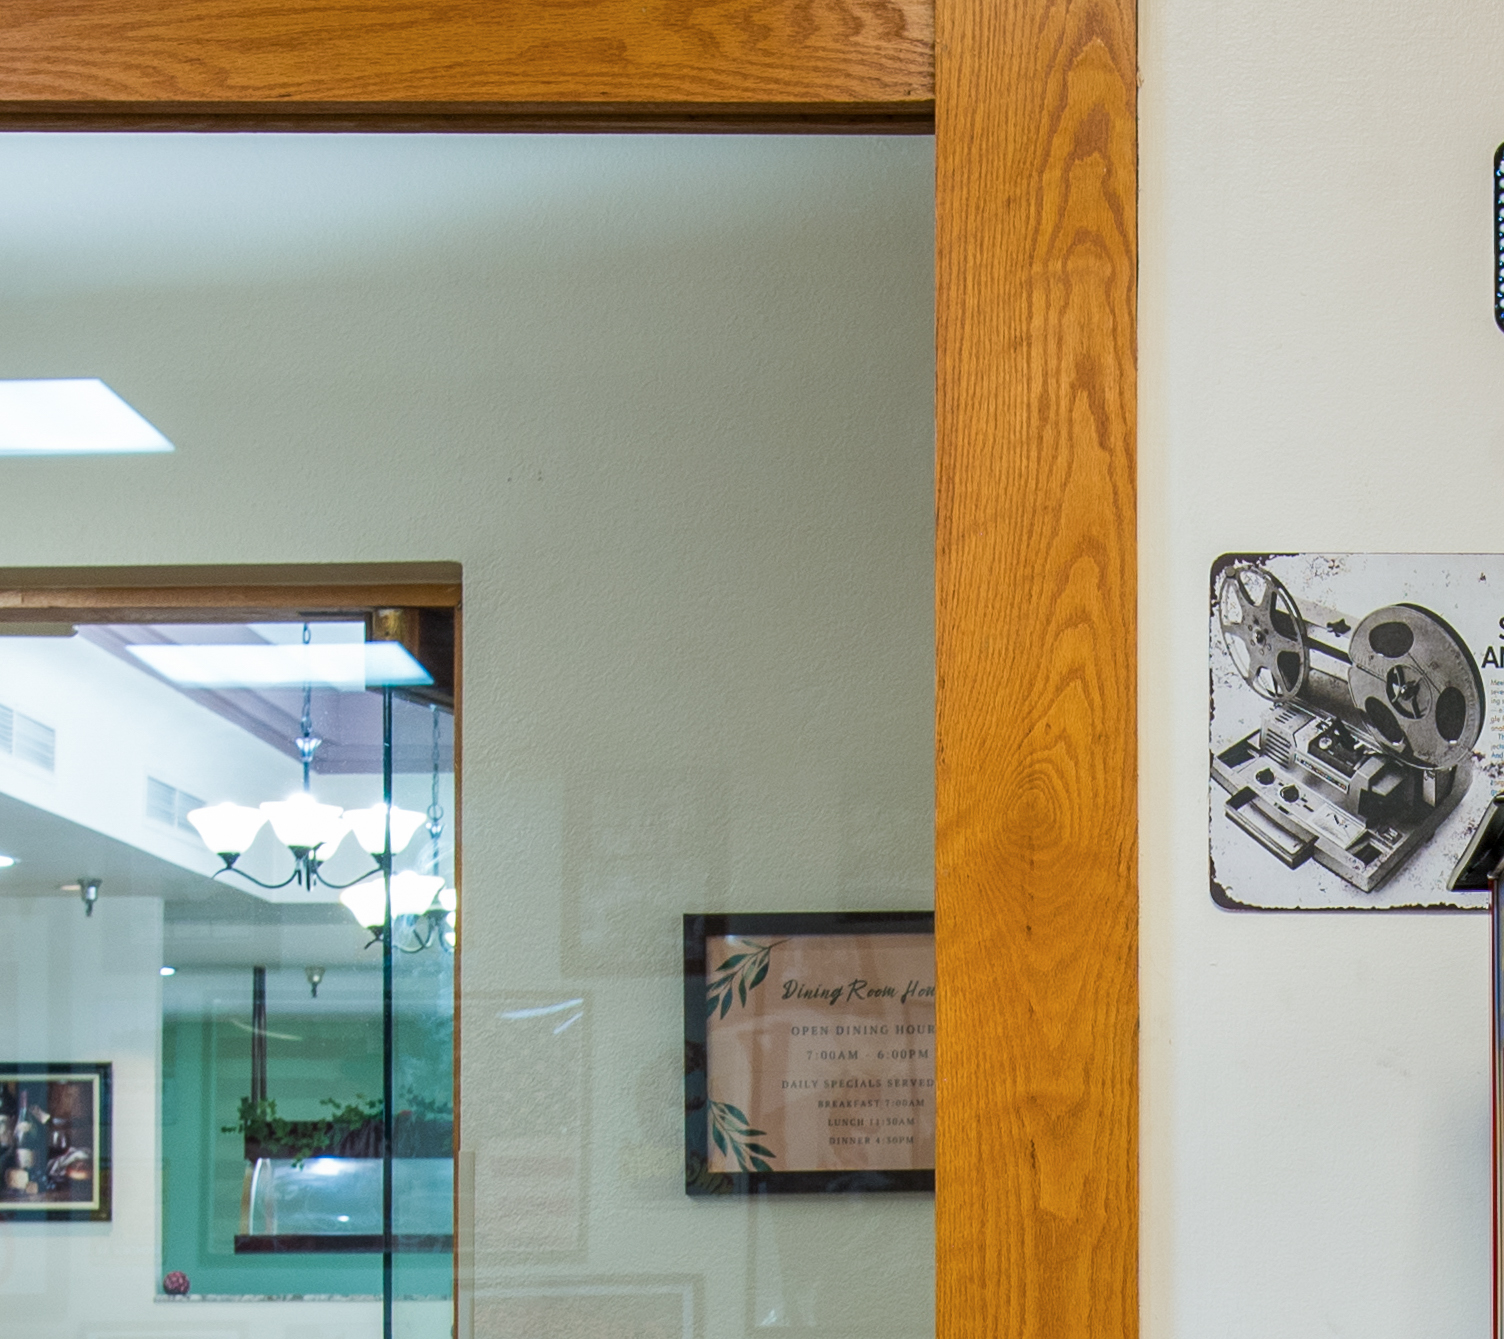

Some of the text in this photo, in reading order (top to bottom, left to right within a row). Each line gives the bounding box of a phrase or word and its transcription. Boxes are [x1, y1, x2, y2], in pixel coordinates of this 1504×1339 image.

[781, 977, 935, 1006] Dining Room Hou
[791, 1024, 935, 1036] OPEN DINING HOUR
[807, 1050, 859, 1061] 7:00AM
[877, 1049, 929, 1060] 6:00PM
[781, 1078, 935, 1089] DAILY SPECIALS SERVED
[817, 1098, 925, 1109] BREAKFAST 7:00AM
[828, 1117, 865, 1127] LUNCH
[828, 1136, 871, 1146] DINNER
